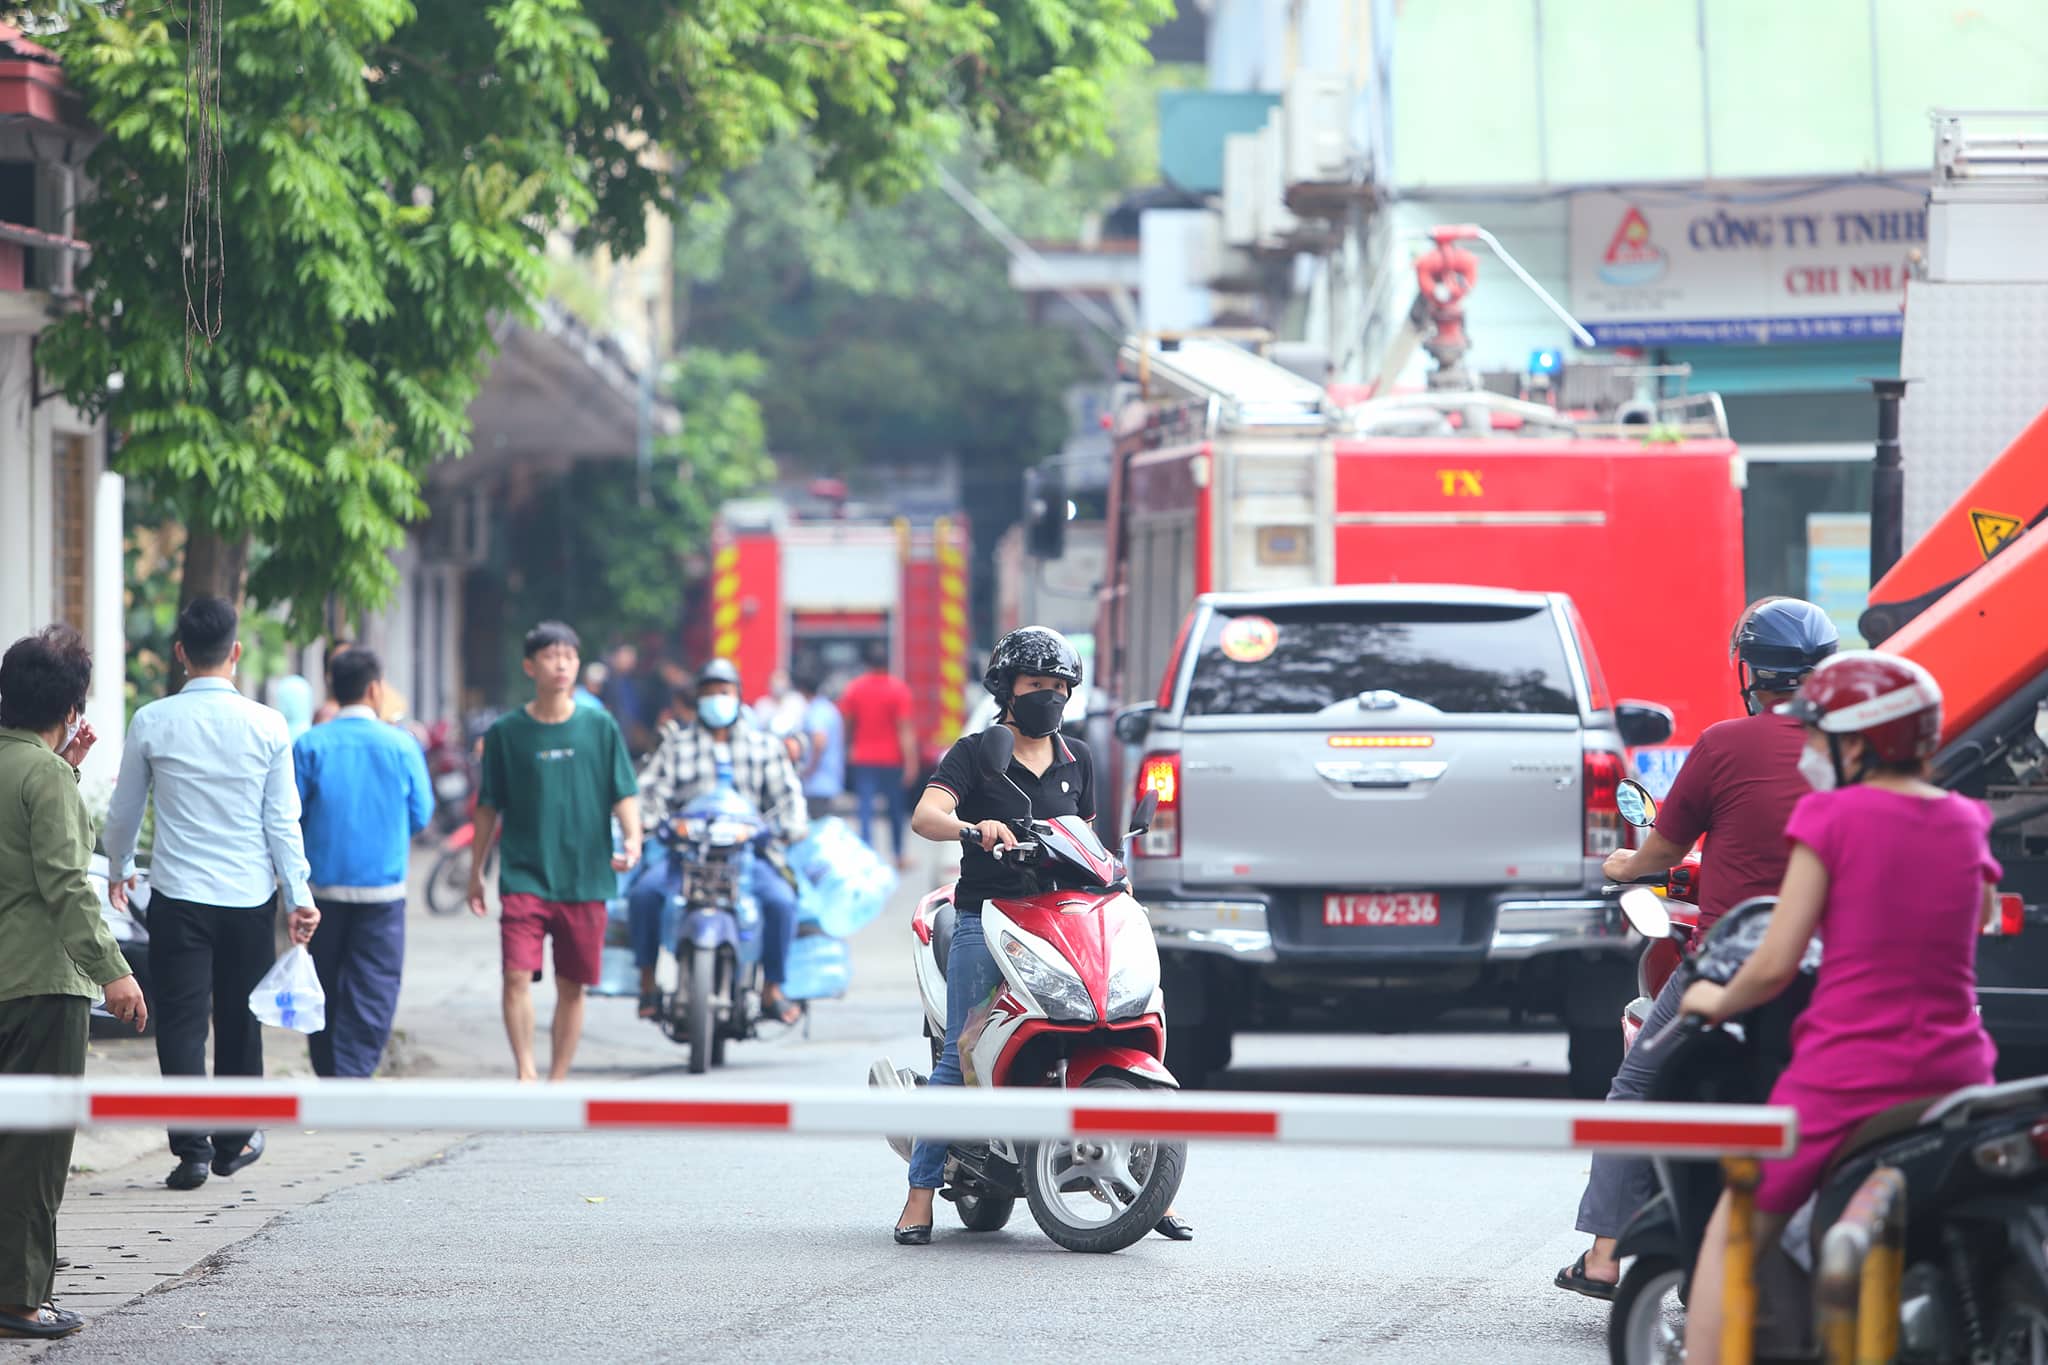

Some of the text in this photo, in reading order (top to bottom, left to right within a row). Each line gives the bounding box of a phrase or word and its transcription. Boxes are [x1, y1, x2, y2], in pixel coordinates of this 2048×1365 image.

[1687, 208, 1774, 250] CÔNG
[1779, 212, 1823, 246] TY
[1832, 208, 1928, 245] TNHH
[1783, 264, 1840, 295] CHI
[1434, 468, 1485, 498] TX
